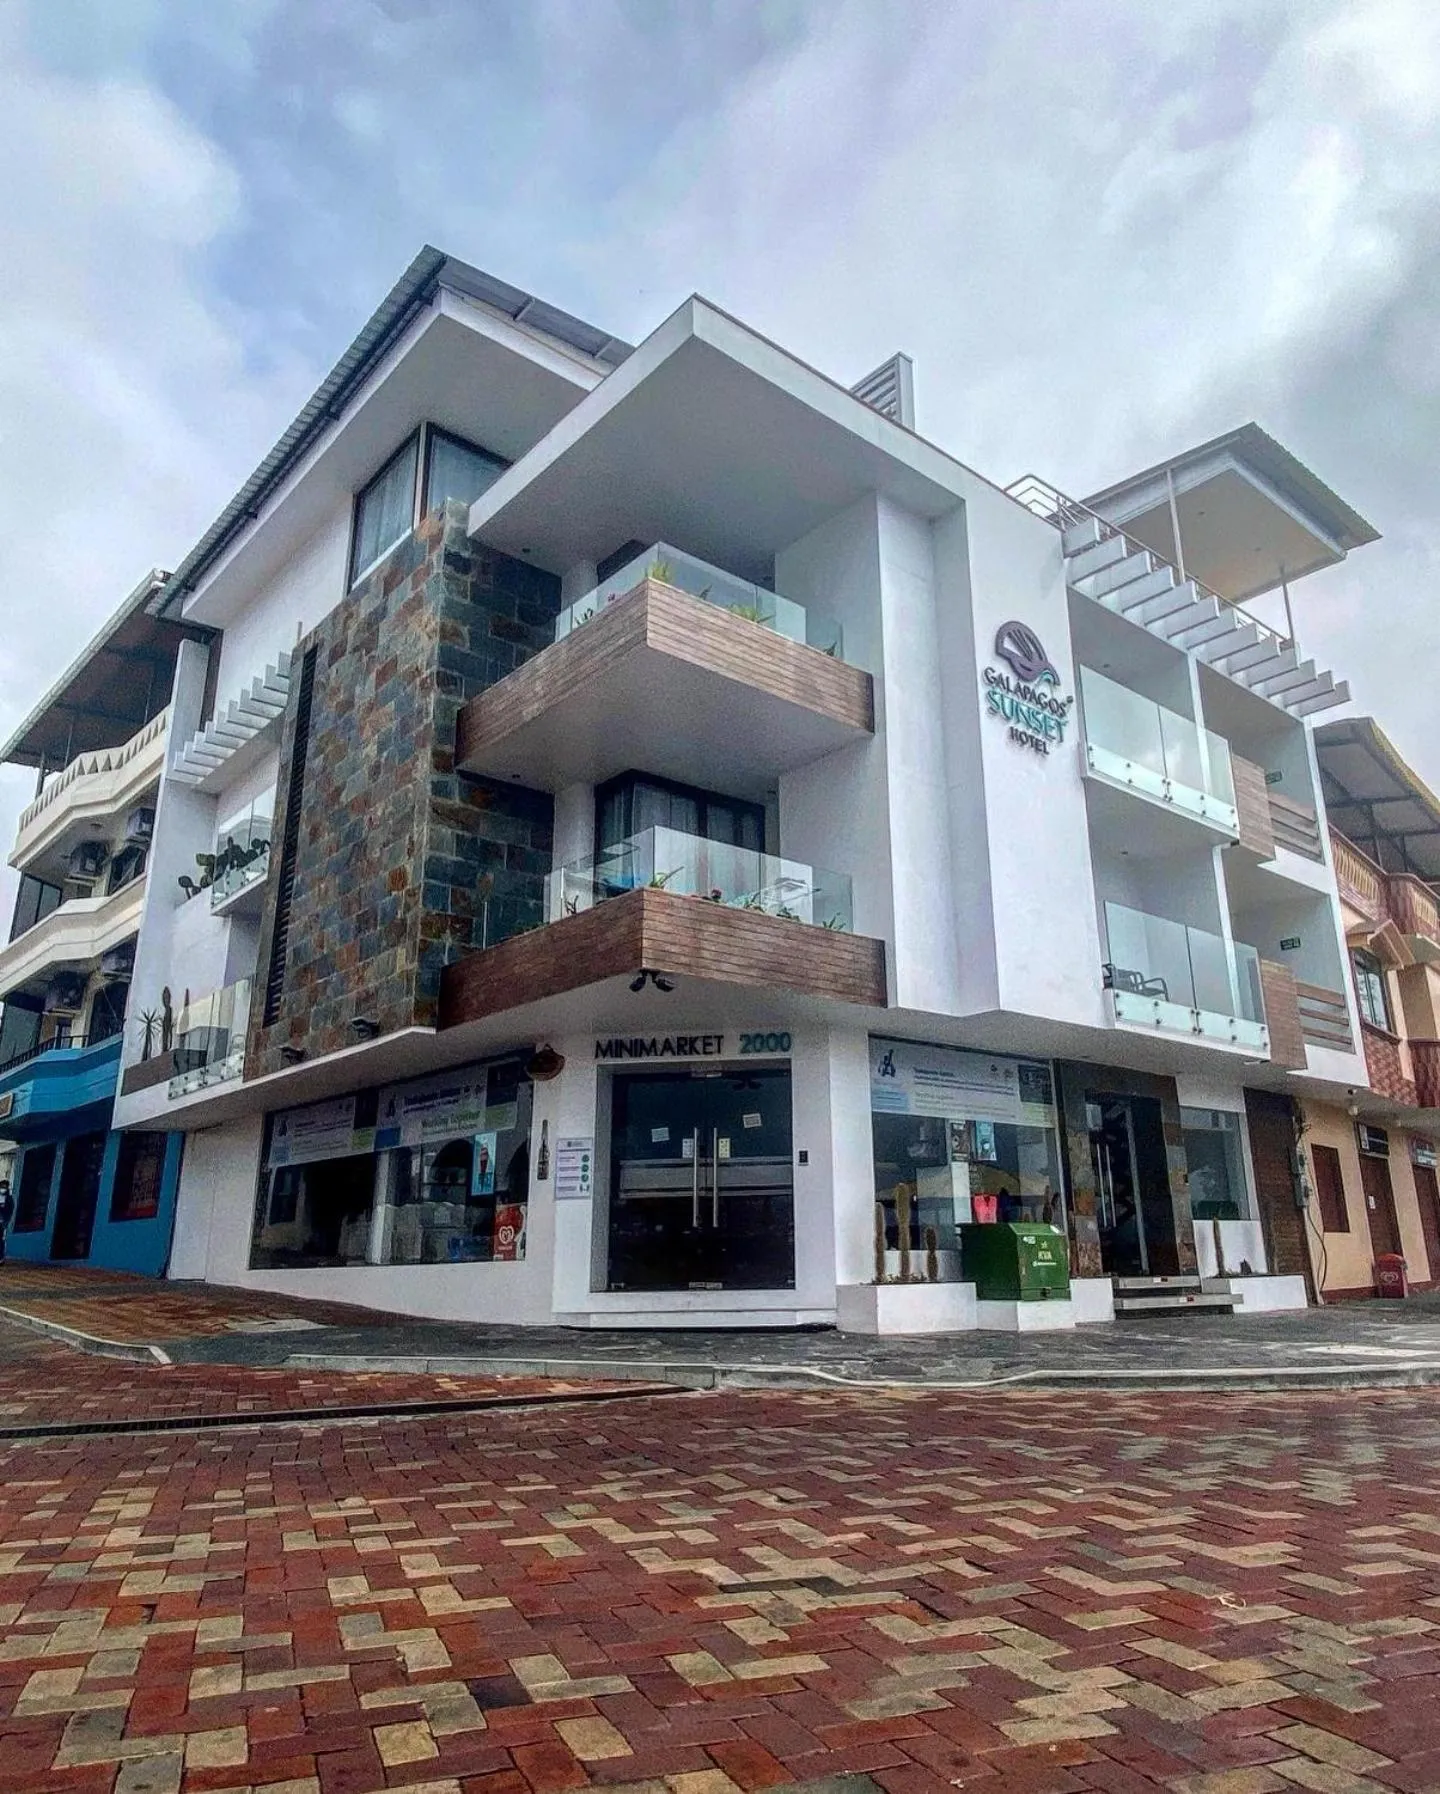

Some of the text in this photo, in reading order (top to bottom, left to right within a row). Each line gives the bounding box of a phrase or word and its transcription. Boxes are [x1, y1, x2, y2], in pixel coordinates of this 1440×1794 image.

[984, 667, 1067, 717] GALAPAGOS
[987, 689, 1068, 743] SUNSET
[1010, 726, 1049, 755] HOTEL
[594, 1032, 791, 1059] MINIMARKET 2000
